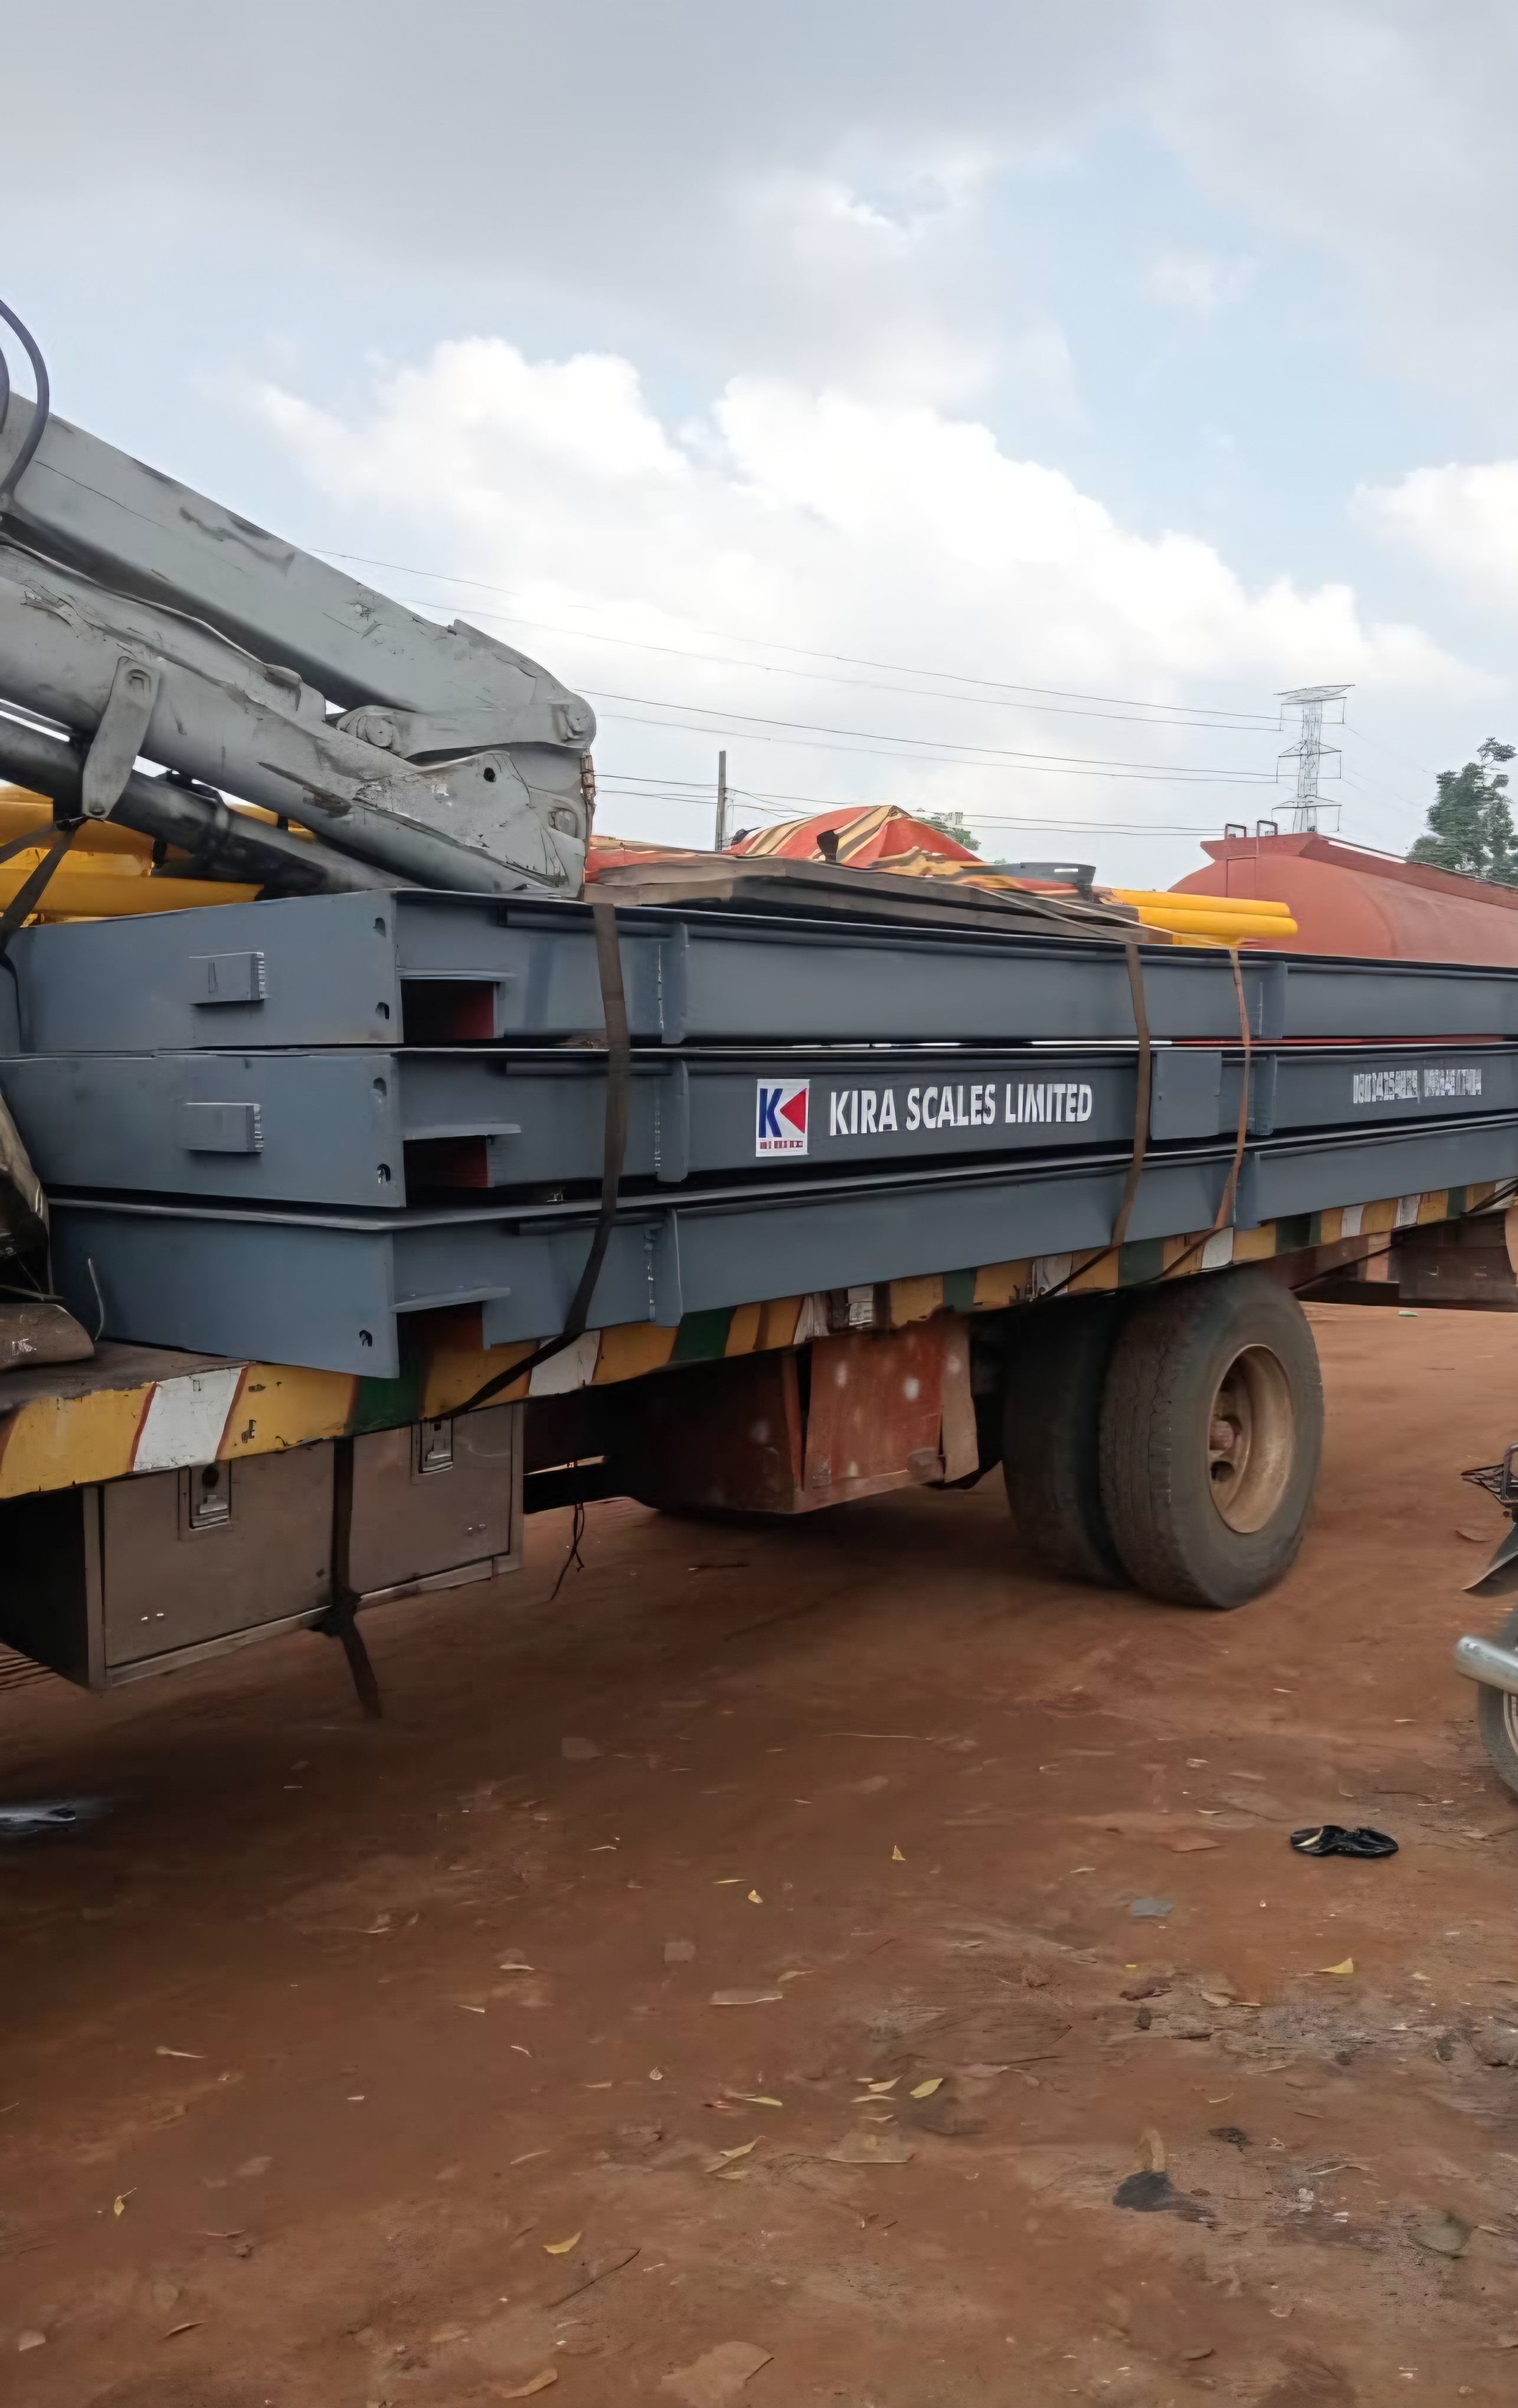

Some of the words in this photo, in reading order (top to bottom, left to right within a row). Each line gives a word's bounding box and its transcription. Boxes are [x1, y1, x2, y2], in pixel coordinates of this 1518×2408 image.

[759, 1088, 783, 1138] K
[830, 1089, 898, 1136] KIRA
[906, 1084, 996, 1131] SCALES
[1005, 1083, 1092, 1123] LIMITED
